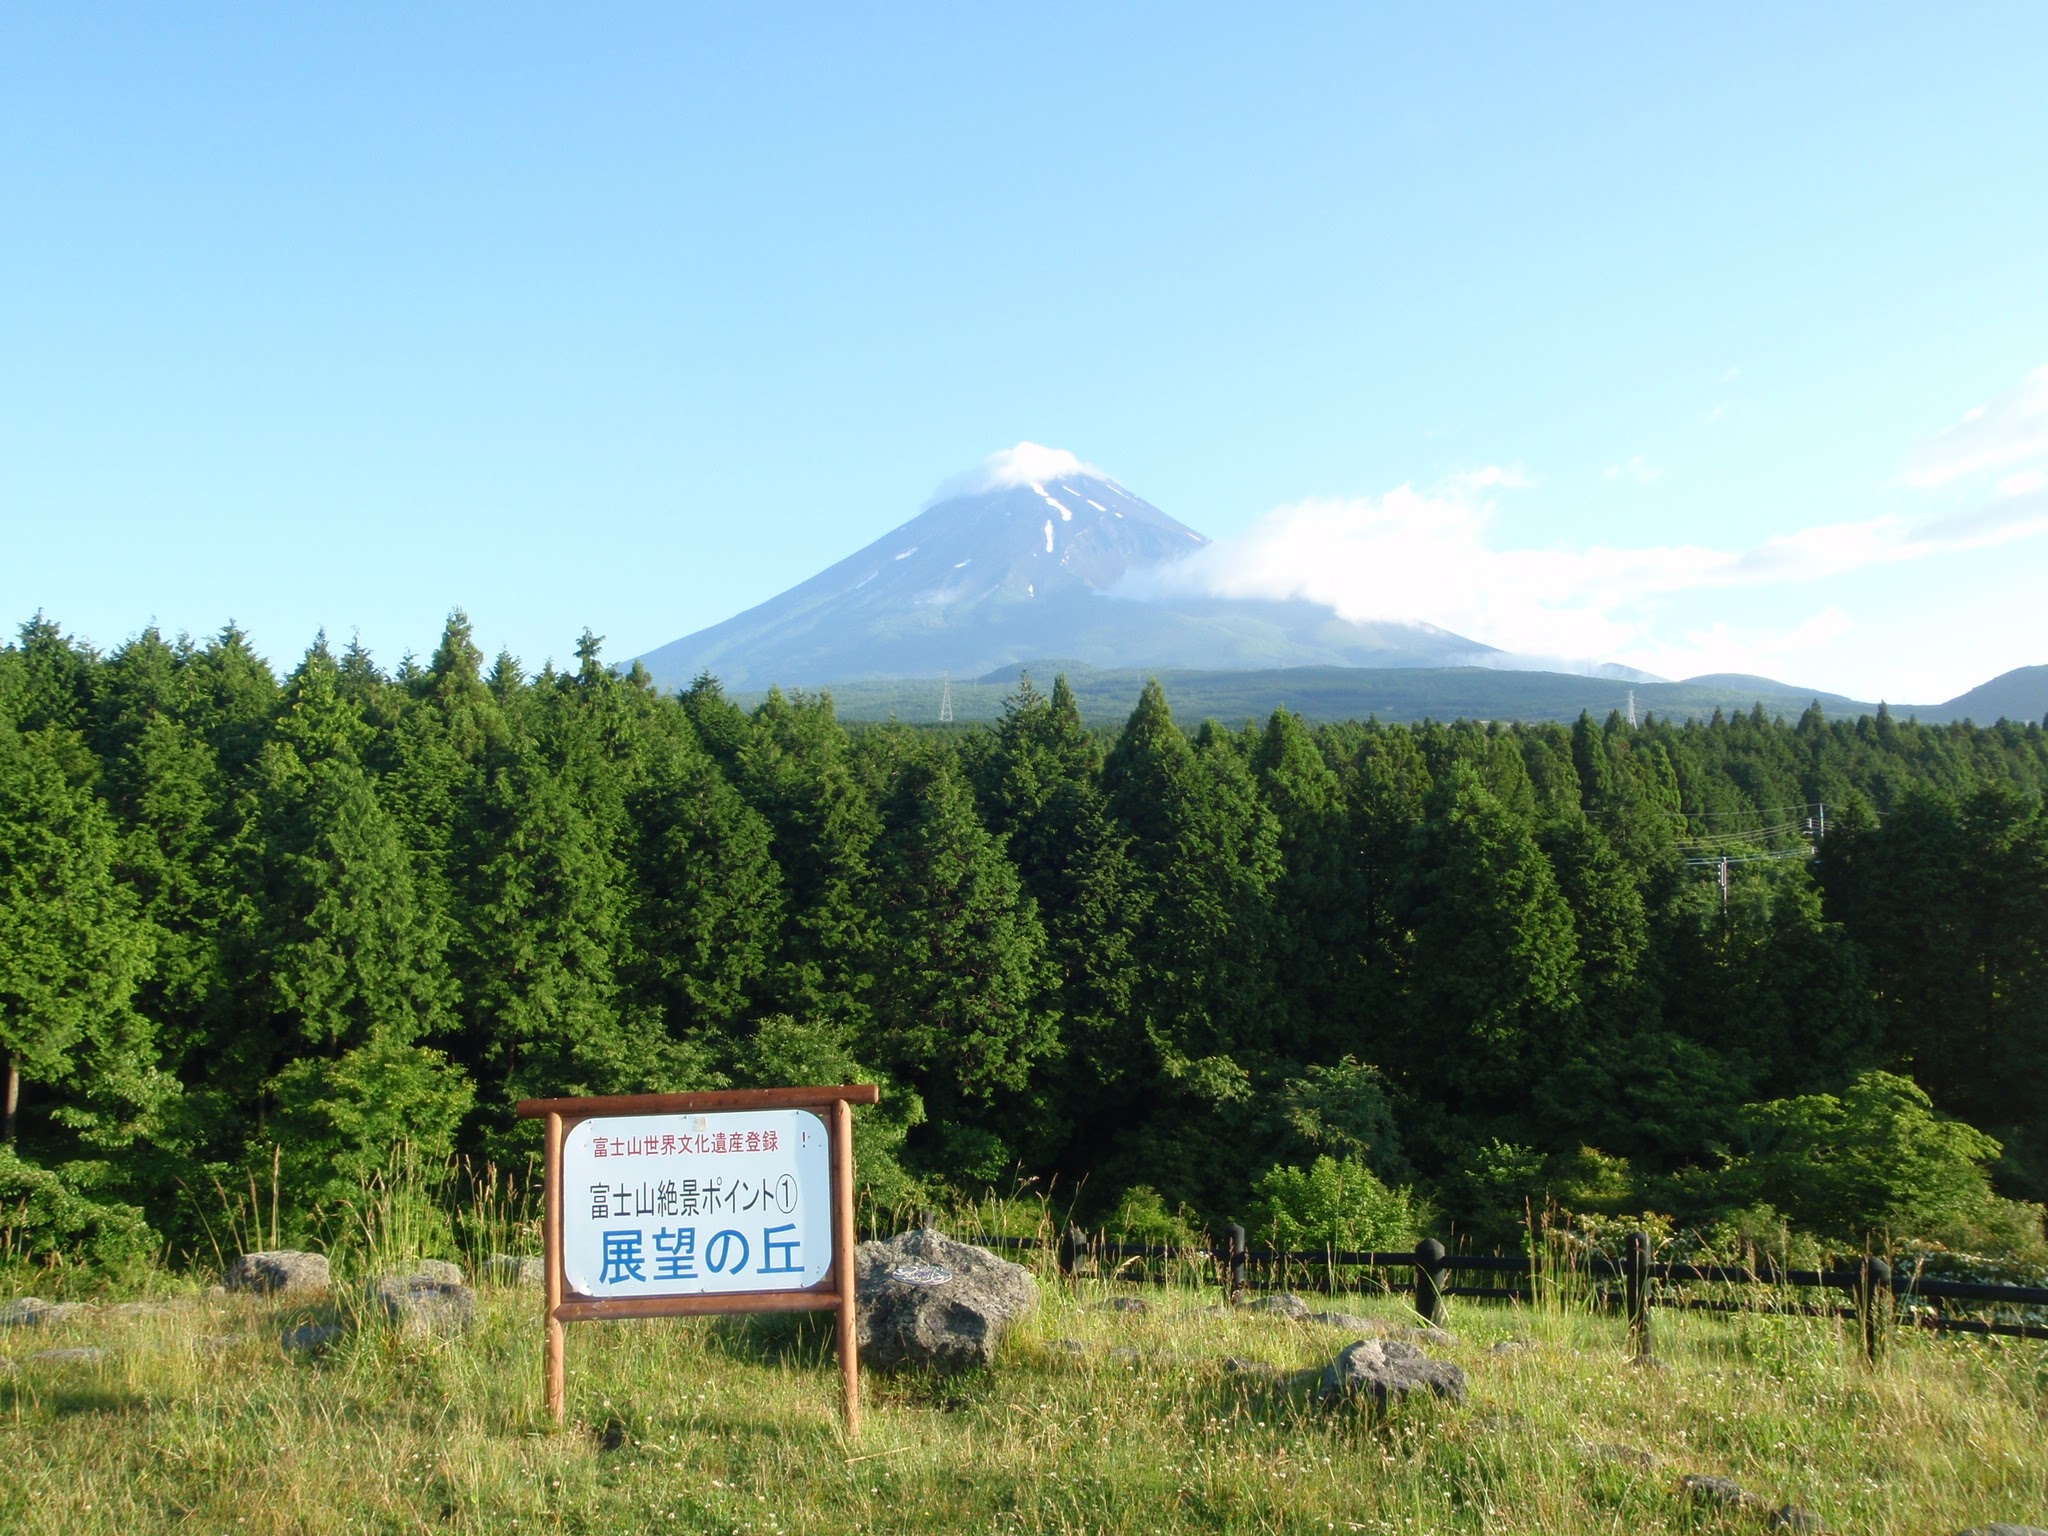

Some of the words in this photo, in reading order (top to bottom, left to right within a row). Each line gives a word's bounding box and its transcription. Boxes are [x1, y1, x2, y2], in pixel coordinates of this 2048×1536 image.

[593, 1131, 779, 1158] 富士山世界文化遺産登録
[589, 1174, 798, 1220] 富士山絶景ポイント①
[599, 1223, 805, 1285] 展望の丘
